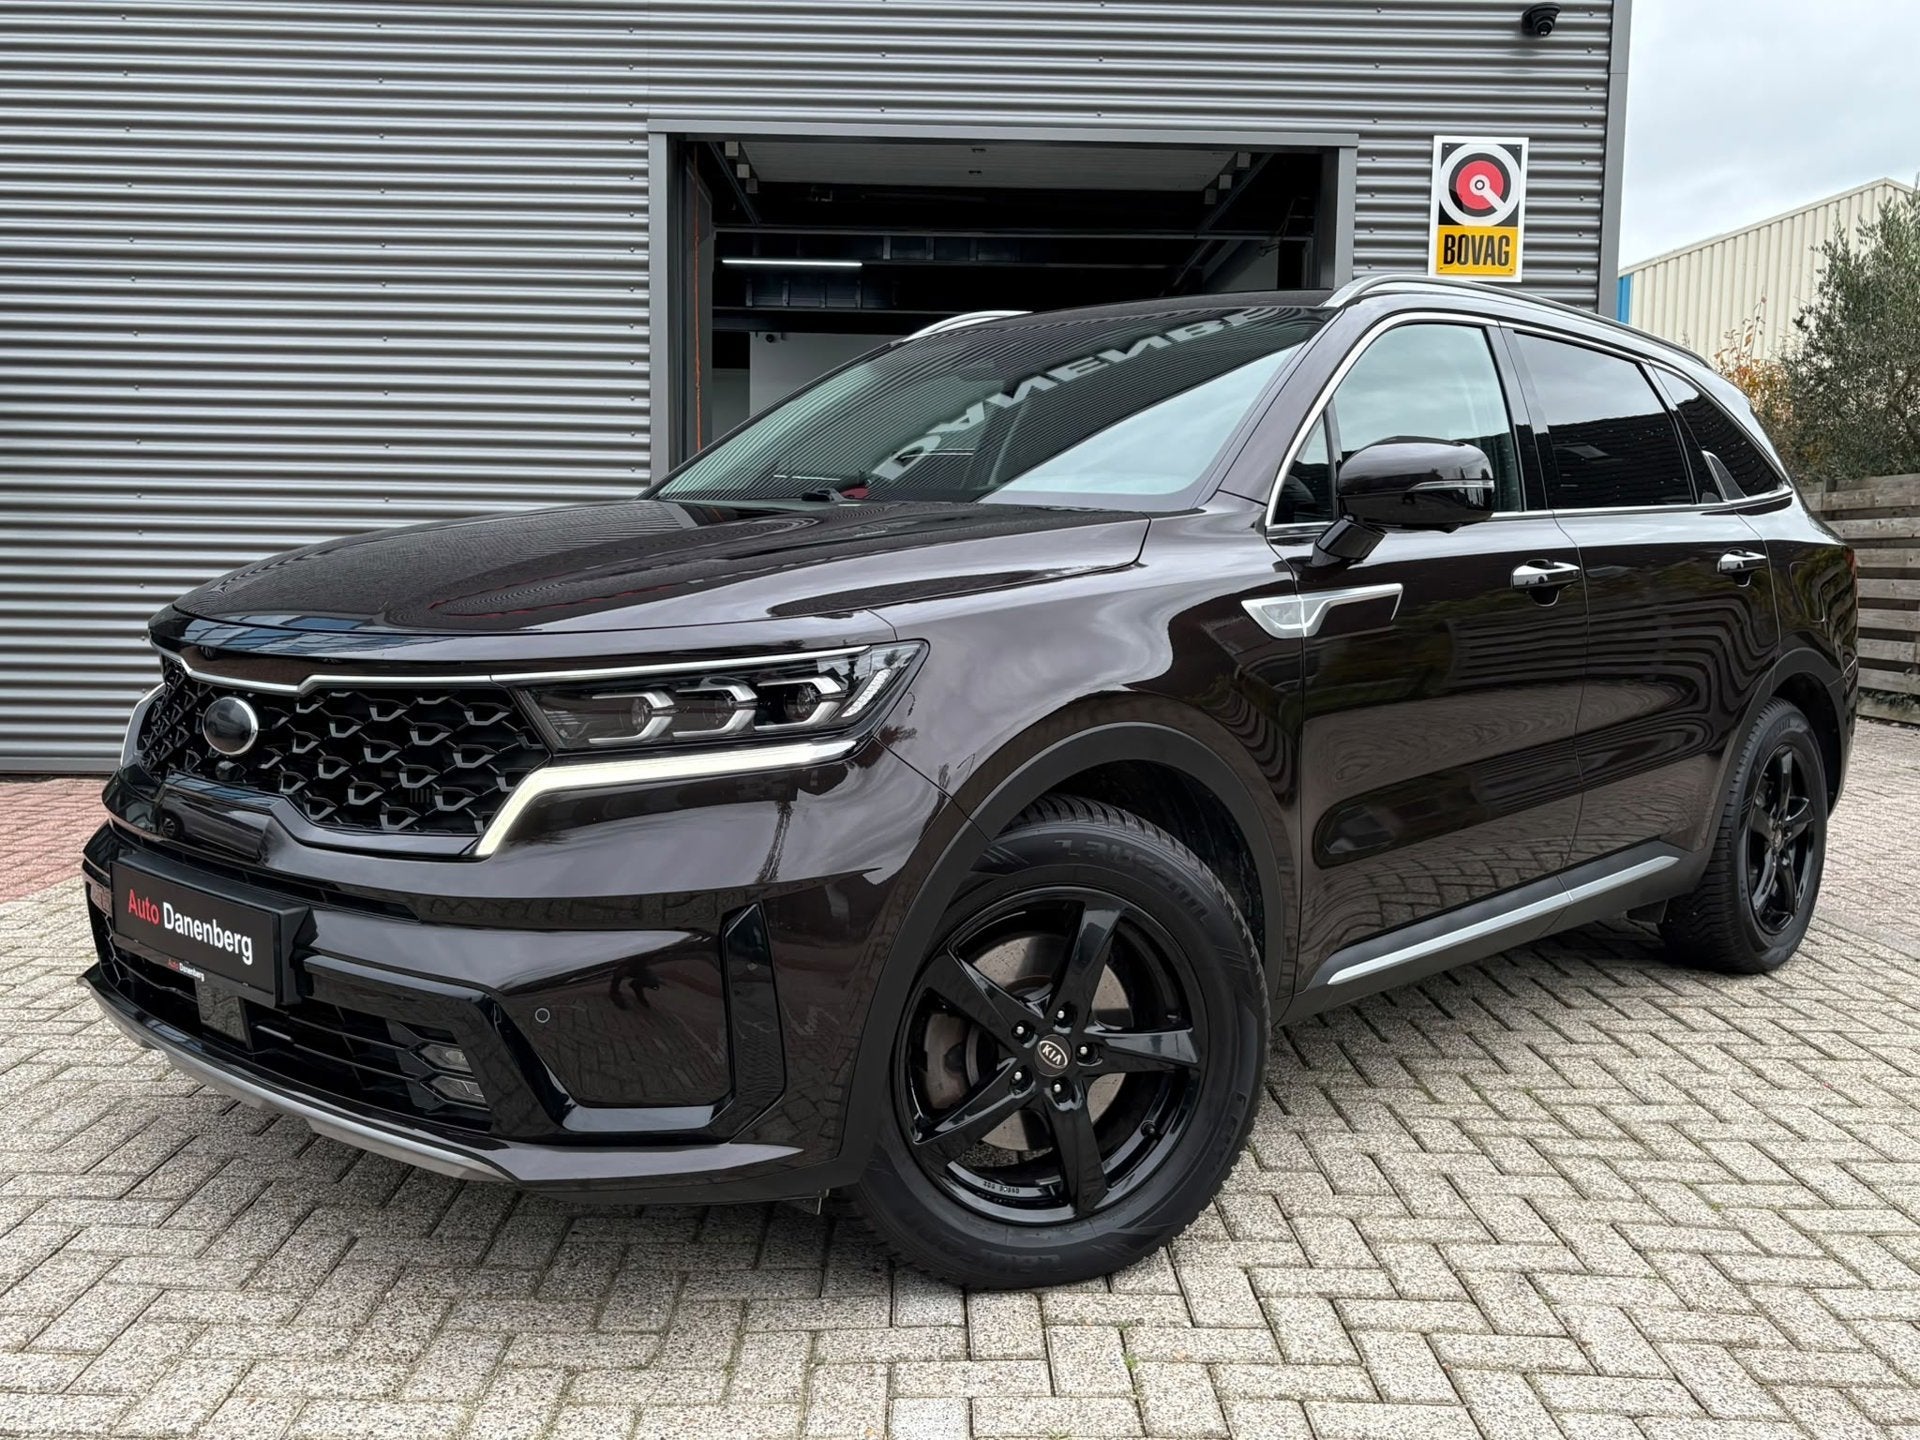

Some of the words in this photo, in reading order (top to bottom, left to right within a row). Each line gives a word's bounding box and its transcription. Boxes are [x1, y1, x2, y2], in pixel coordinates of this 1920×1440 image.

[1443, 234, 1511, 266] BOVAG
[128, 888, 160, 925] Auto
[162, 902, 254, 965] Danenberg
[1042, 1044, 1062, 1065] KIA
